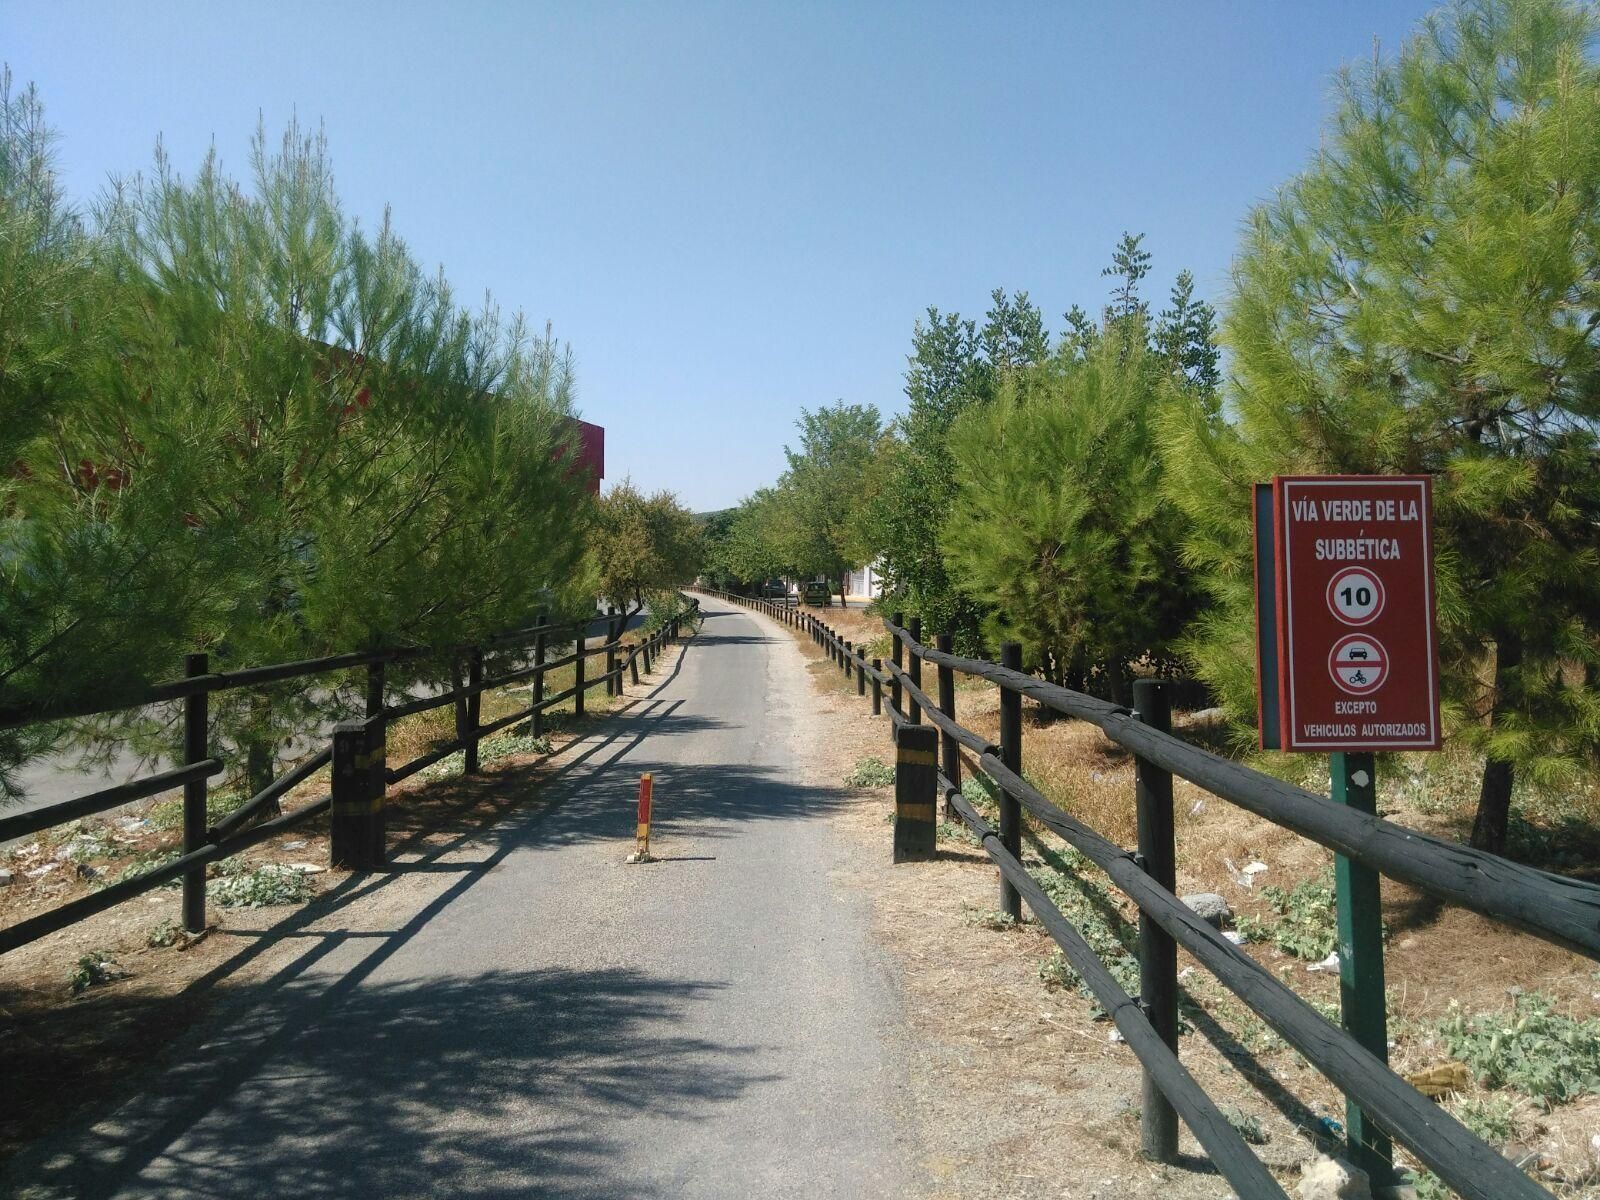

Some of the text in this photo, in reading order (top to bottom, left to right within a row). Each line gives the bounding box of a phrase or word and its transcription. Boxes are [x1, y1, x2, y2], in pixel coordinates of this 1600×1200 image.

[1292, 495, 1419, 522] VÍA VERDE DE LA
[1315, 528, 1401, 561] SUBBÉTICA
[1340, 587, 1371, 606] 10
[1335, 701, 1377, 715] EXCEPTO
[1304, 722, 1426, 737] VEHICULOS AUTORIZADOS
